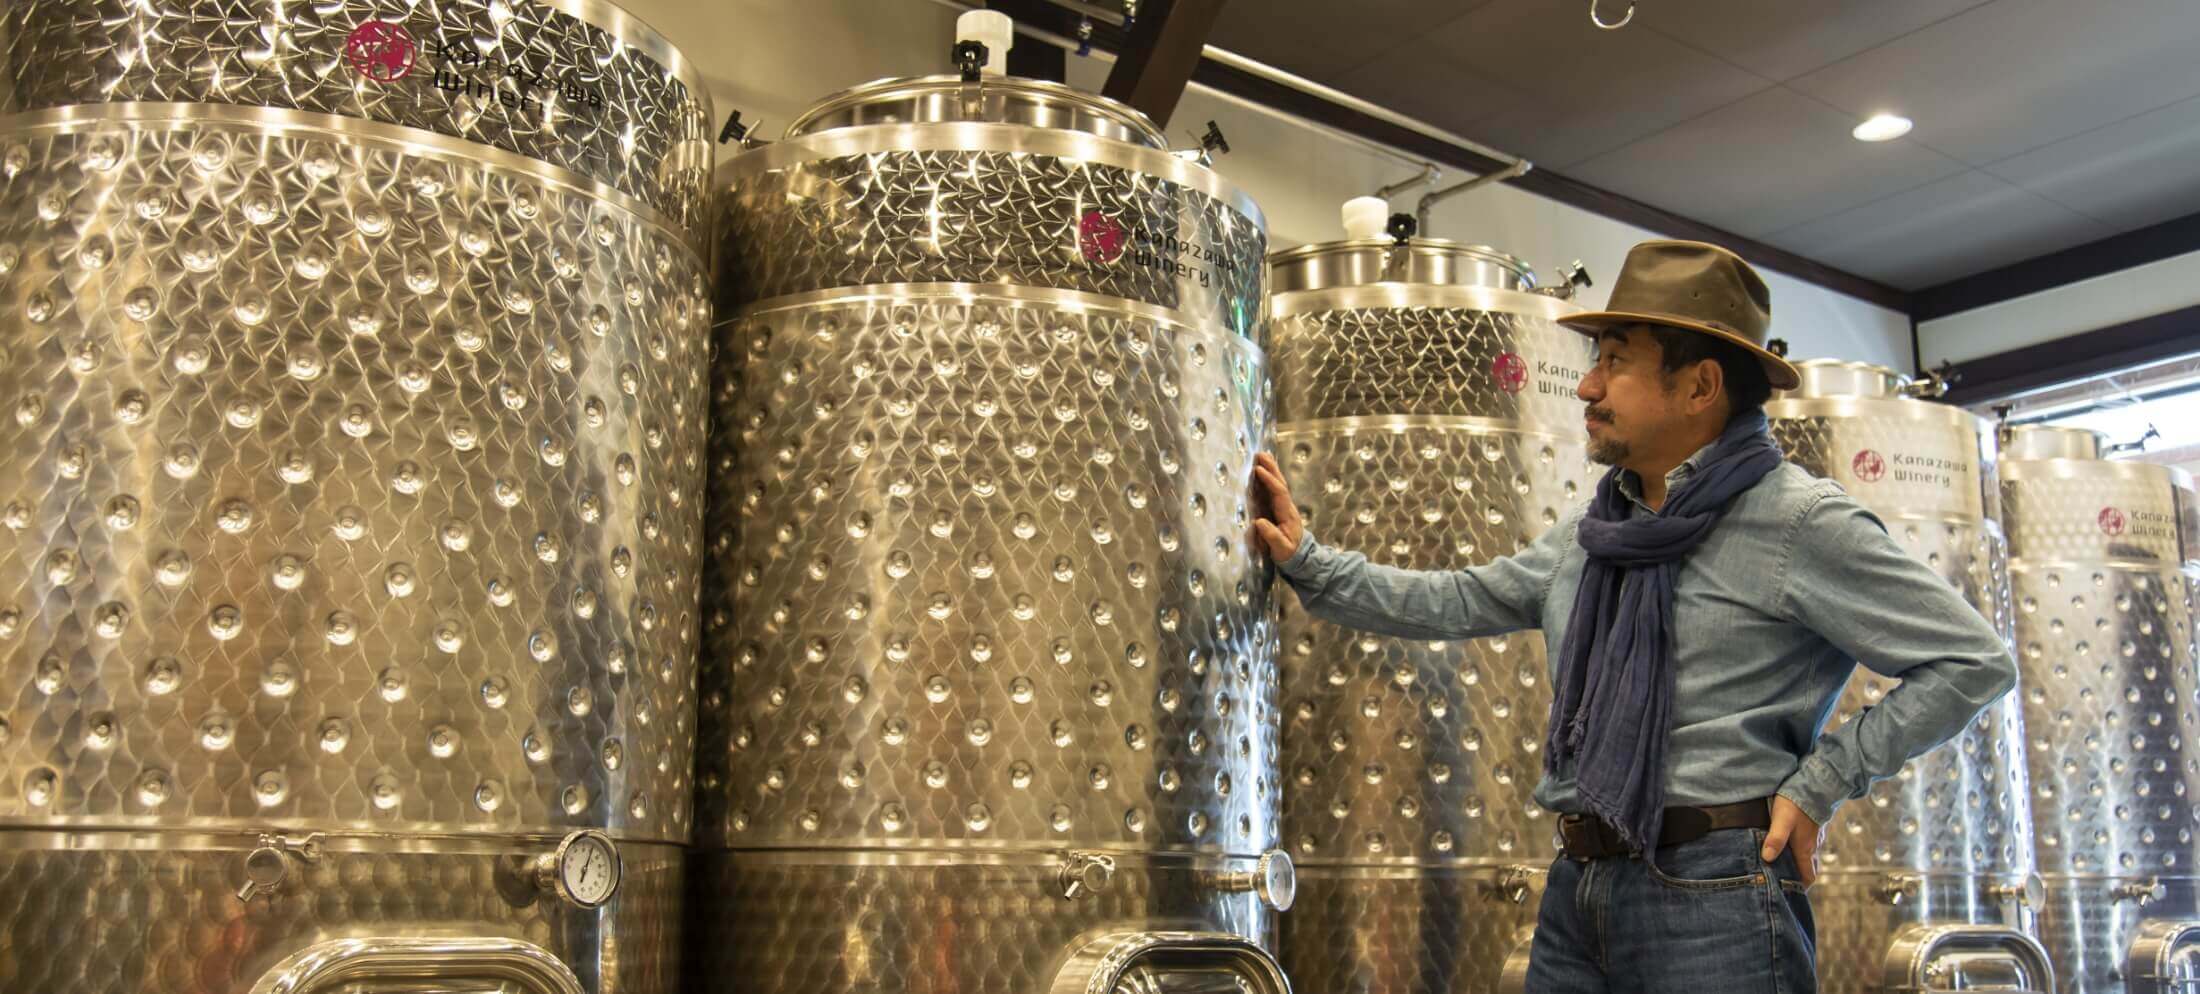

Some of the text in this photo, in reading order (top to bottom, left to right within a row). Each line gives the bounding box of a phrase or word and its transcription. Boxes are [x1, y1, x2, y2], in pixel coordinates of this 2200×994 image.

[1134, 226, 1235, 271] Kanazawa
[1134, 249, 1210, 288] Winery
[1537, 360, 1584, 382] Kana
[1537, 380, 1578, 400] Wine
[1893, 453, 1968, 473] Kanazawa
[1894, 469, 1951, 488] Winery
[2130, 509, 2170, 523] Kanaz
